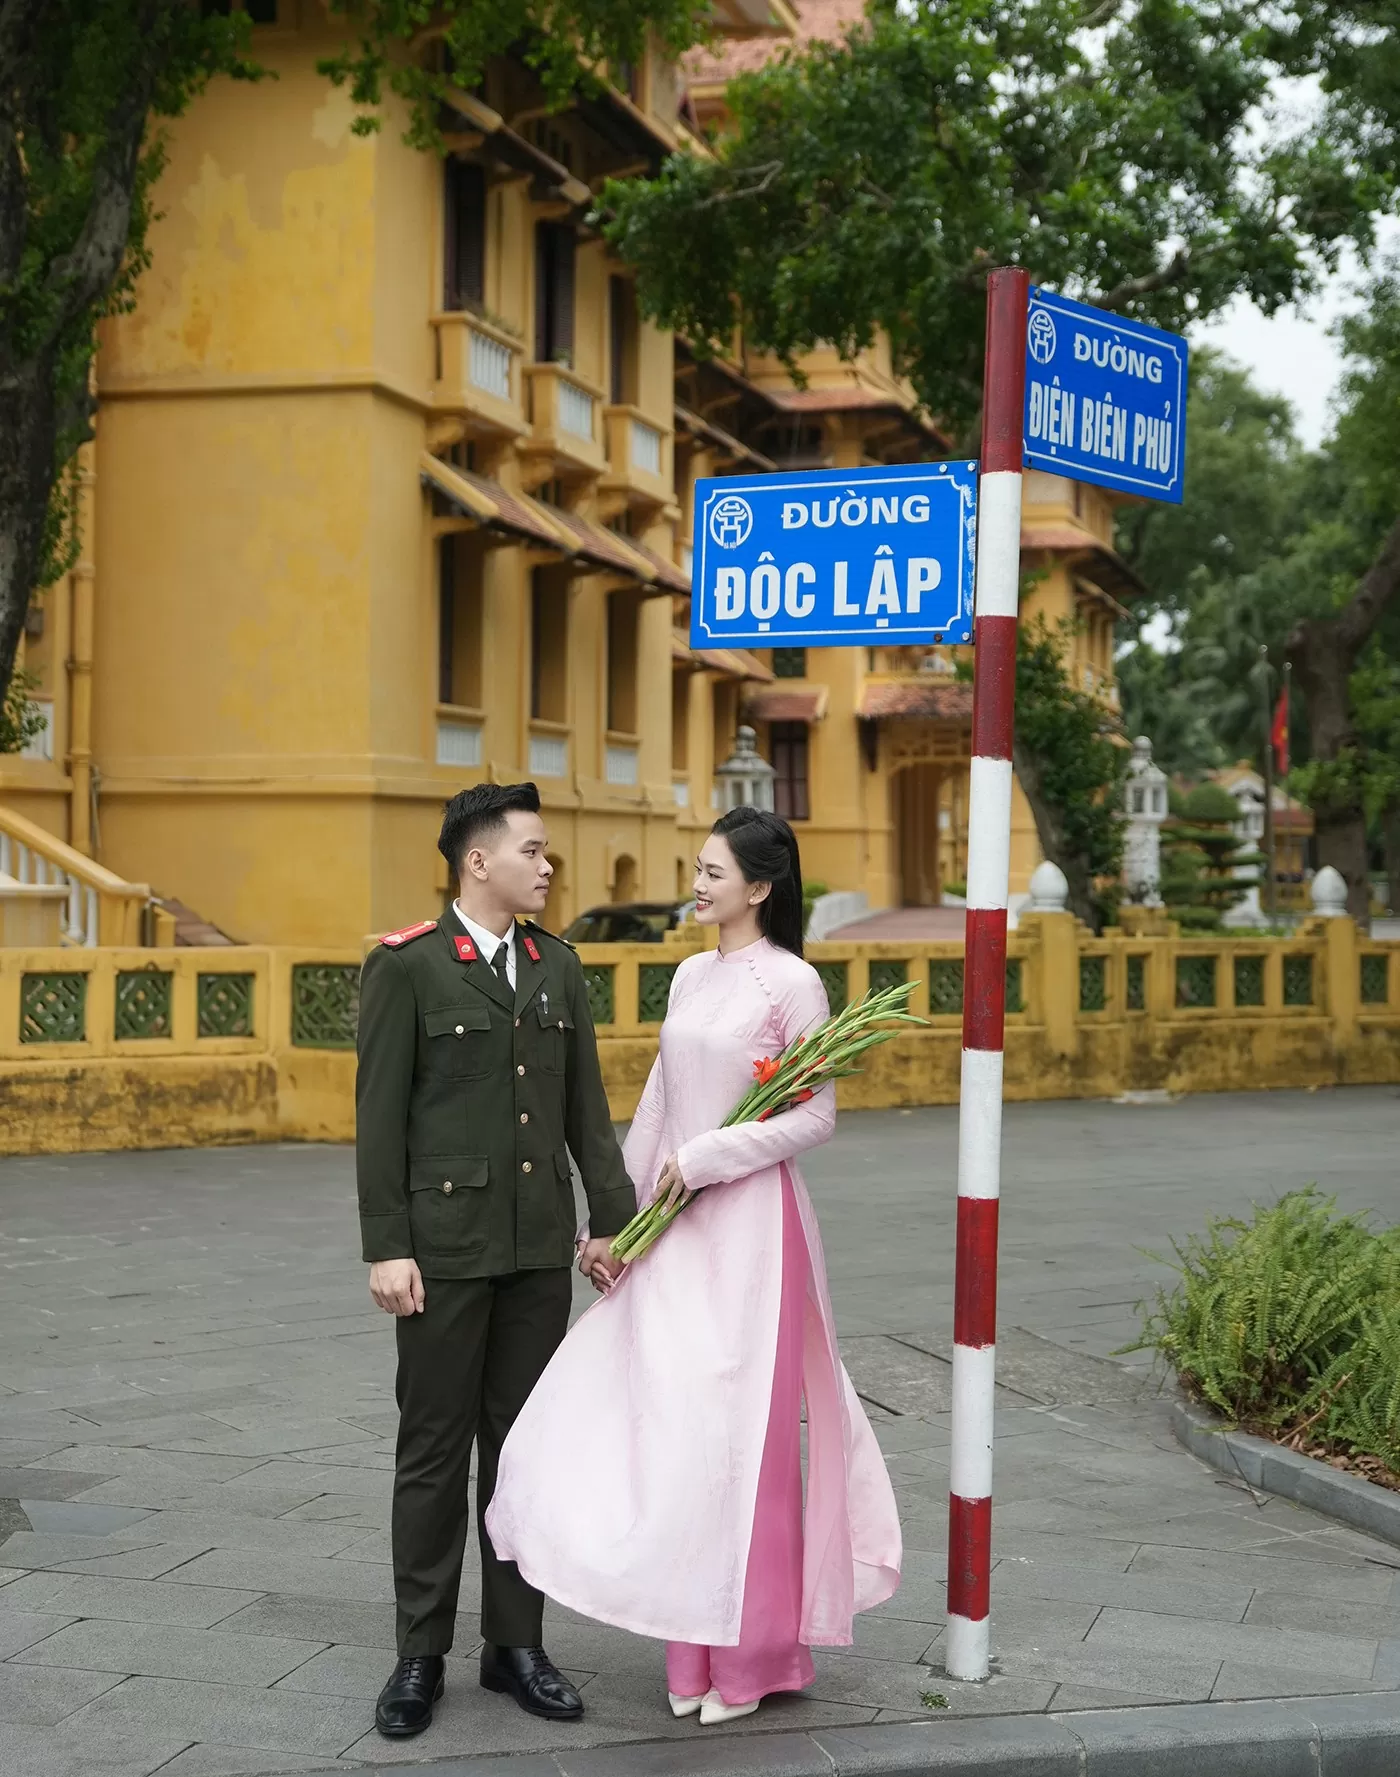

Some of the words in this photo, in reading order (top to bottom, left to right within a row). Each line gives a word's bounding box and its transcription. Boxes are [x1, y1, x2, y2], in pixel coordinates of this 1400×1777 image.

[1074, 332, 1163, 384] ĐƯỜNG
[1029, 375, 1076, 455] ĐIỆN
[1080, 391, 1127, 462] BIÊN
[1132, 400, 1172, 474] PHỦ
[781, 489, 930, 530] ĐƯỜNG
[714, 551, 816, 632] ĐỘC
[833, 545, 942, 628] LẬP
